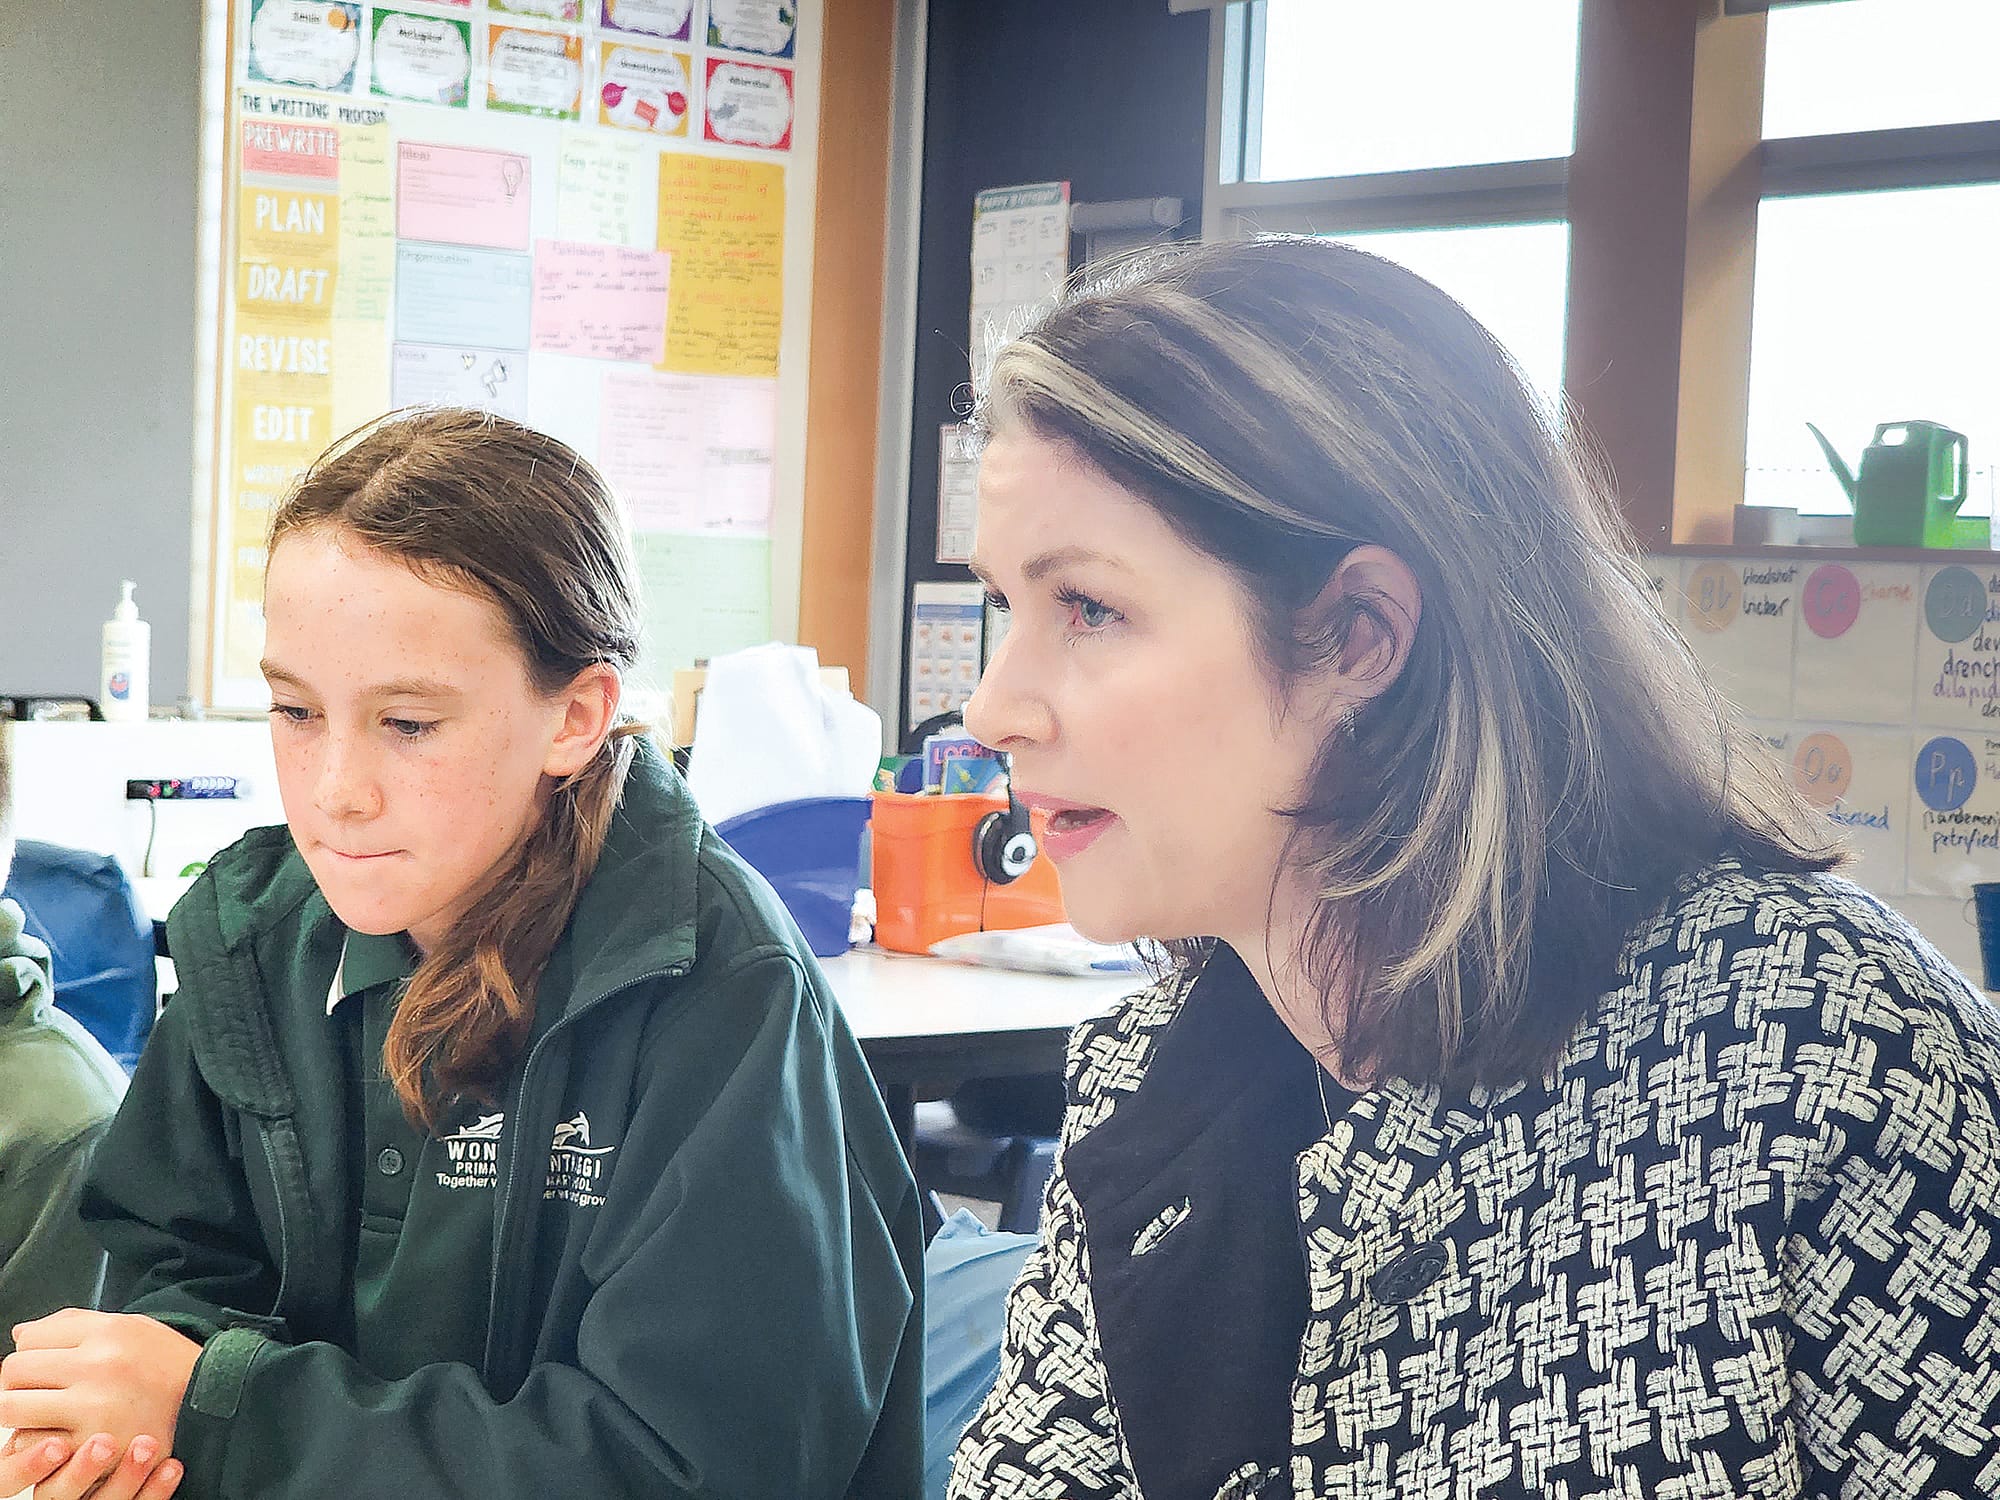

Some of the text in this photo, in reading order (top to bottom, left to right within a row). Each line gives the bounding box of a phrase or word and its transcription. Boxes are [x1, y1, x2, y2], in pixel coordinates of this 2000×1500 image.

[270, 98, 330, 120] WRITING
[244, 124, 338, 157] PREWRITE
[255, 196, 325, 234] PLAN
[247, 265, 330, 304] DRAFT
[239, 336, 330, 374] REVISE
[253, 405, 314, 442] EDIT
[1930, 751, 1966, 803] Pp
[1932, 827, 2000, 855] petrified
[435, 1172, 489, 1189] Together
[456, 1161, 497, 1176] PRIMA
